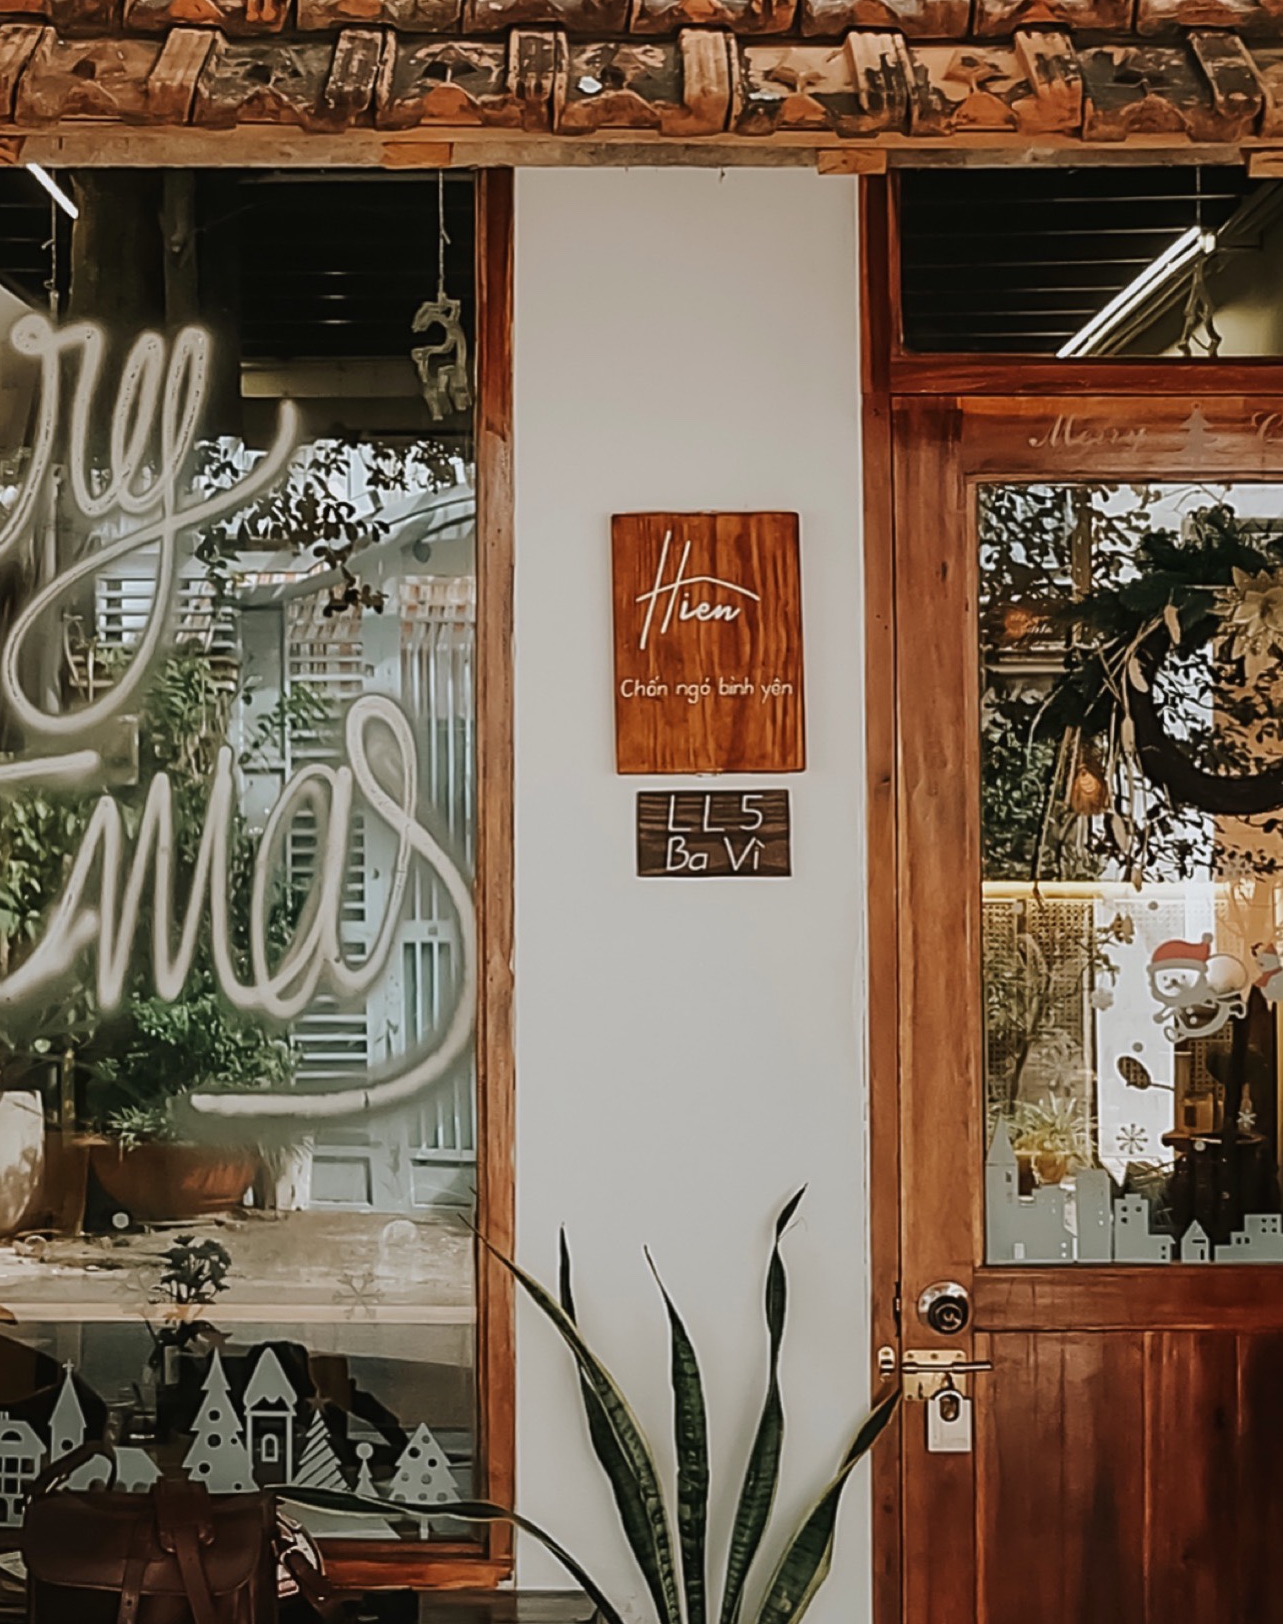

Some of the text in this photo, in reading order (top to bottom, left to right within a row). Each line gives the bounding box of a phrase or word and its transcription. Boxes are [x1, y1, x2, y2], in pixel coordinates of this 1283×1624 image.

[620, 675, 668, 698] Chốn
[718, 675, 755, 696] bình
[760, 678, 793, 705] yên
[665, 835, 765, 872] Ba Vì
